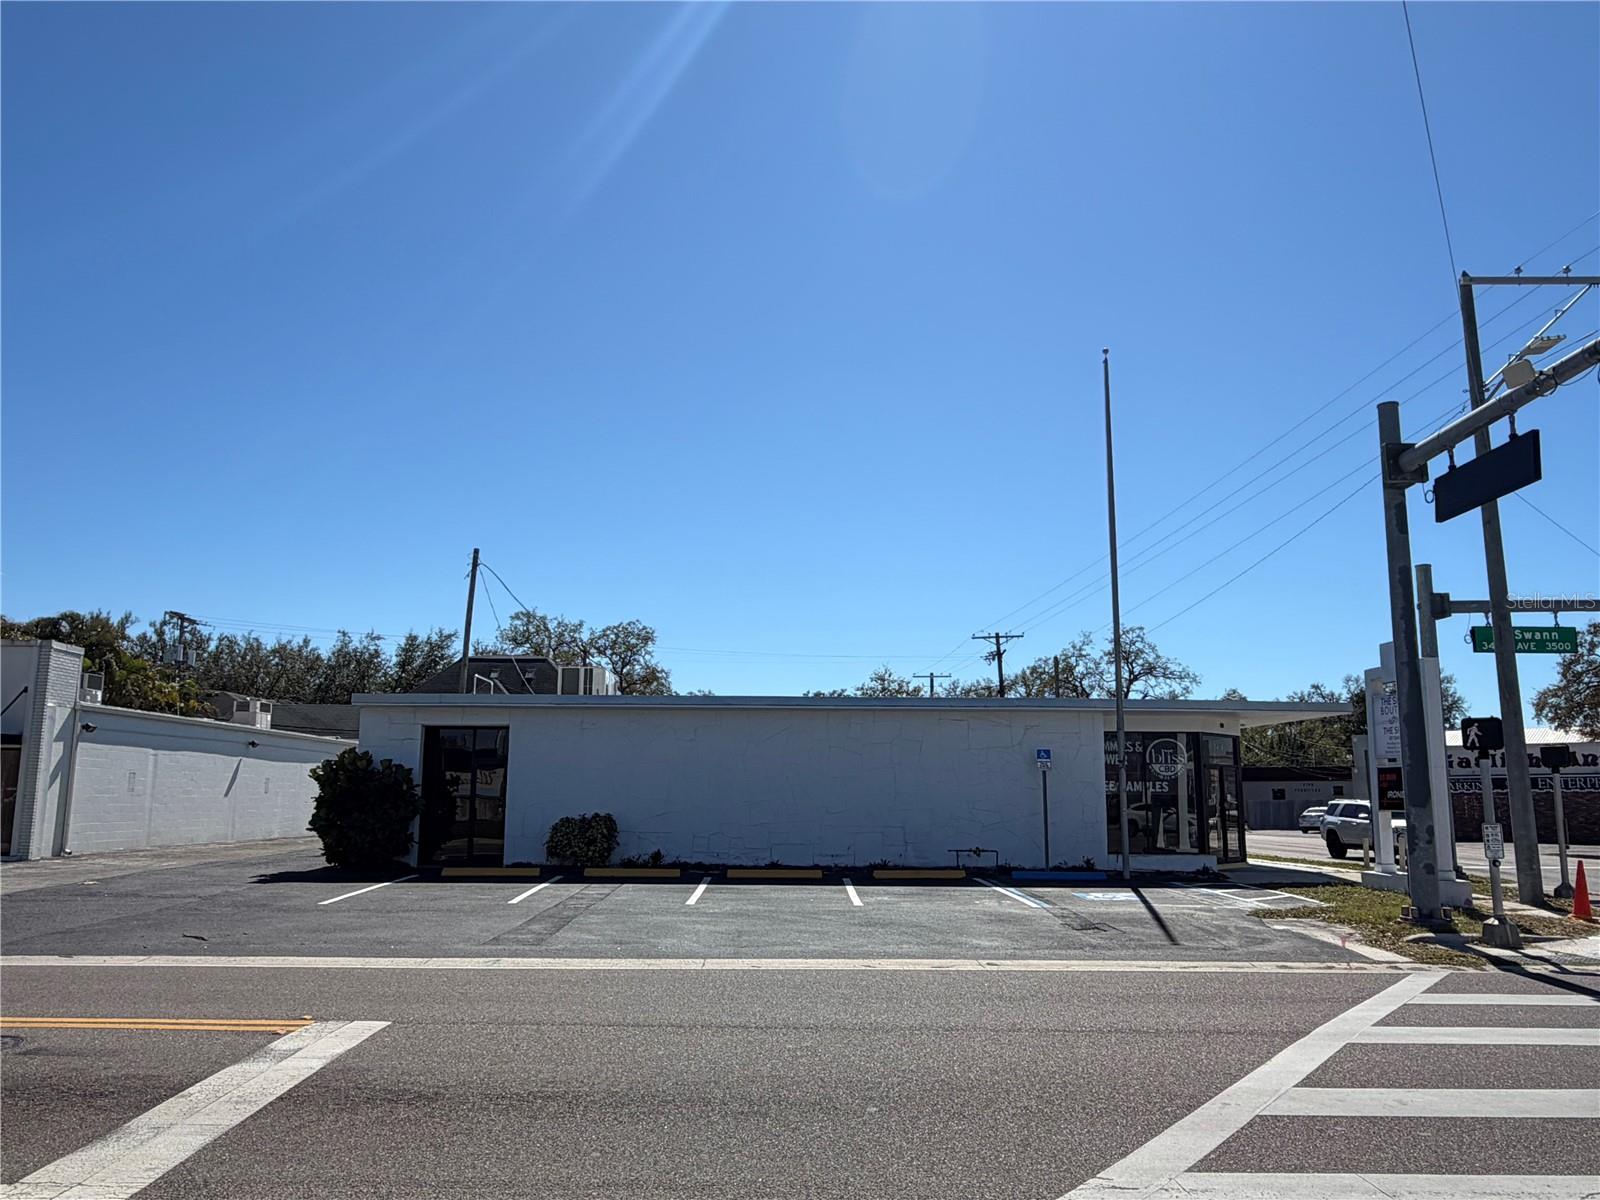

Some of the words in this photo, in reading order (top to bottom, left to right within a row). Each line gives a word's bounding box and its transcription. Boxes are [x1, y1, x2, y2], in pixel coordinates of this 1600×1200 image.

[1514, 629, 1559, 640] Swann
[1516, 642, 1537, 650] AVE
[1545, 642, 1571, 650] 3500
[1158, 765, 1176, 773] CBD
[1117, 781, 1169, 792] AMPLES
